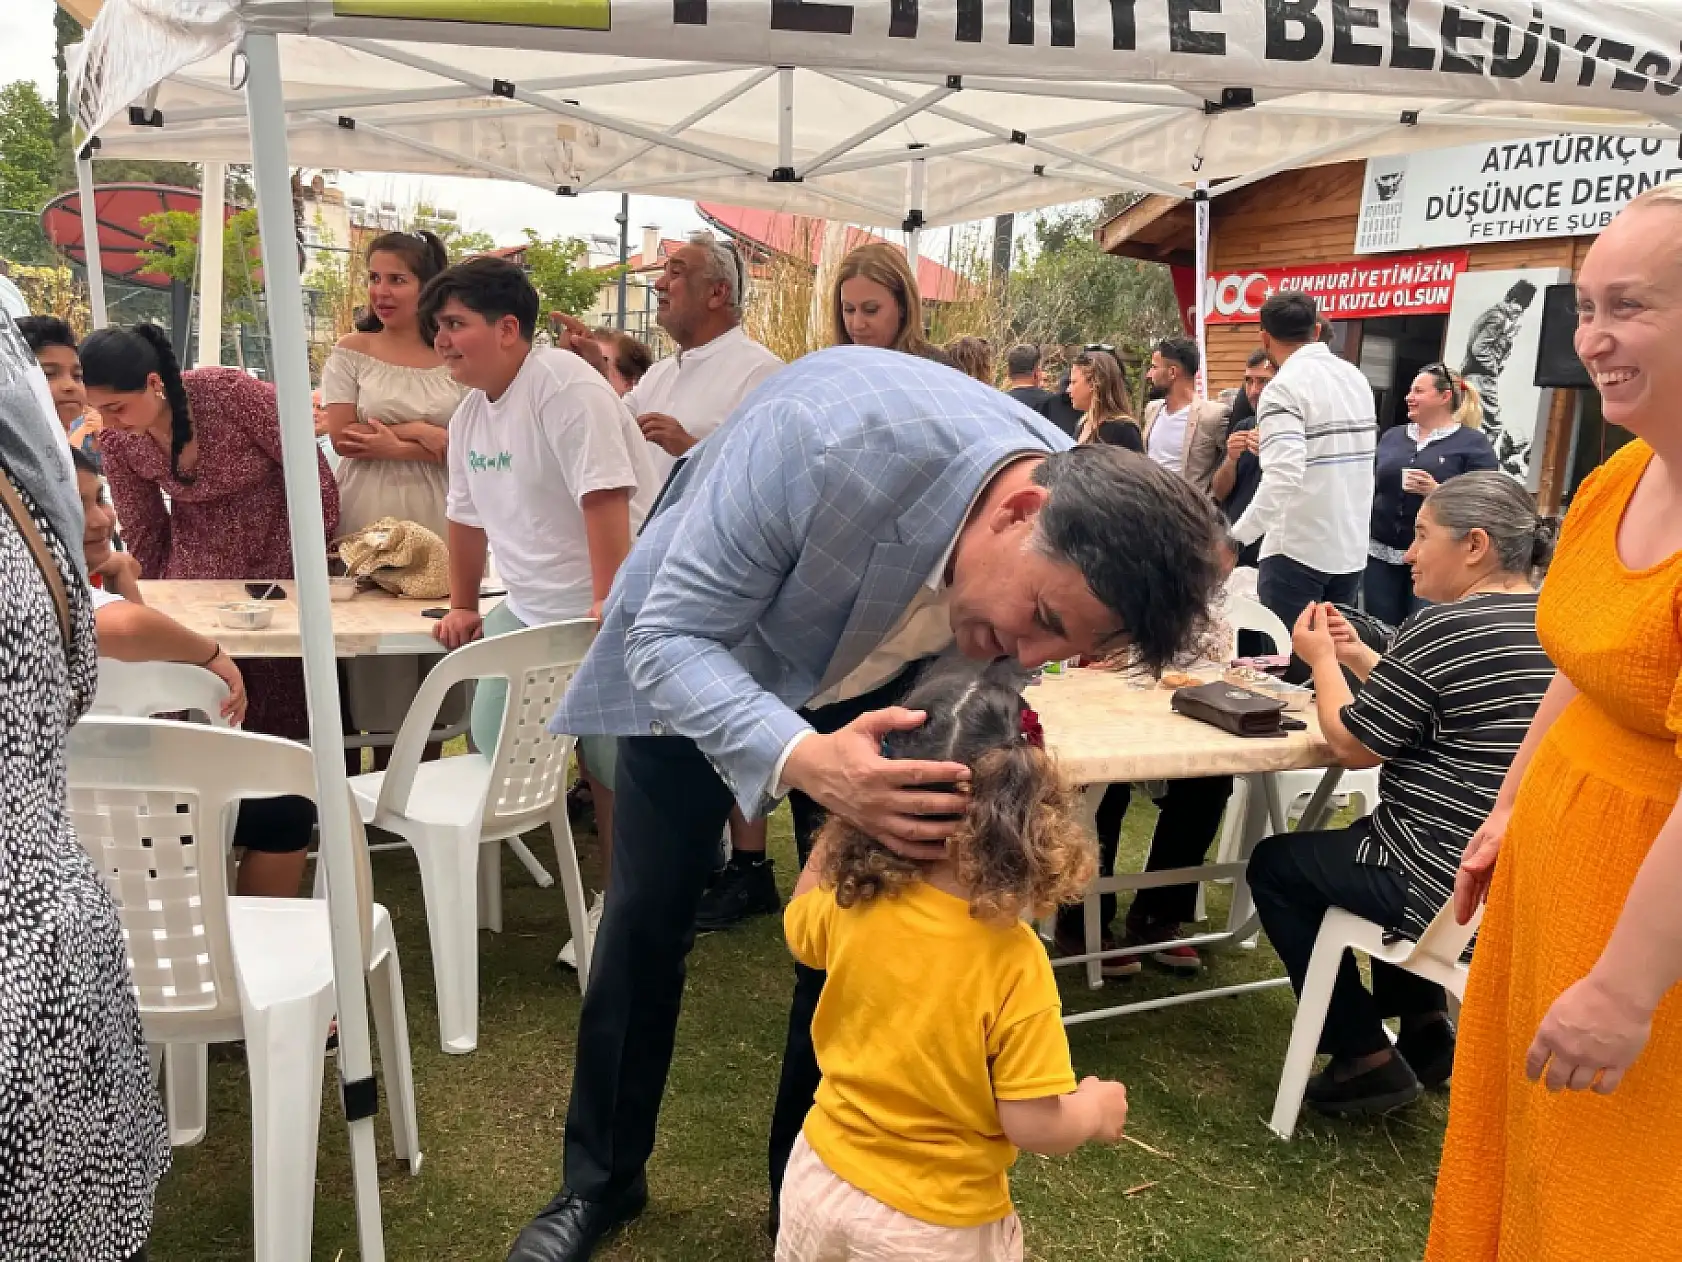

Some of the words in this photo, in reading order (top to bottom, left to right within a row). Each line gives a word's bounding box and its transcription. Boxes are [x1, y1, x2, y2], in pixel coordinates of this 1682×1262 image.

[1425, 180, 1563, 223] DÜŞÜNCE
[1469, 214, 1559, 238] FETHİYE
[1566, 210, 1623, 232] ŞUB
[1279, 260, 1455, 292] CUMHURİYETİMİZİN
[1338, 290, 1391, 310] KUTLU
[1393, 286, 1451, 306] OLSUN
